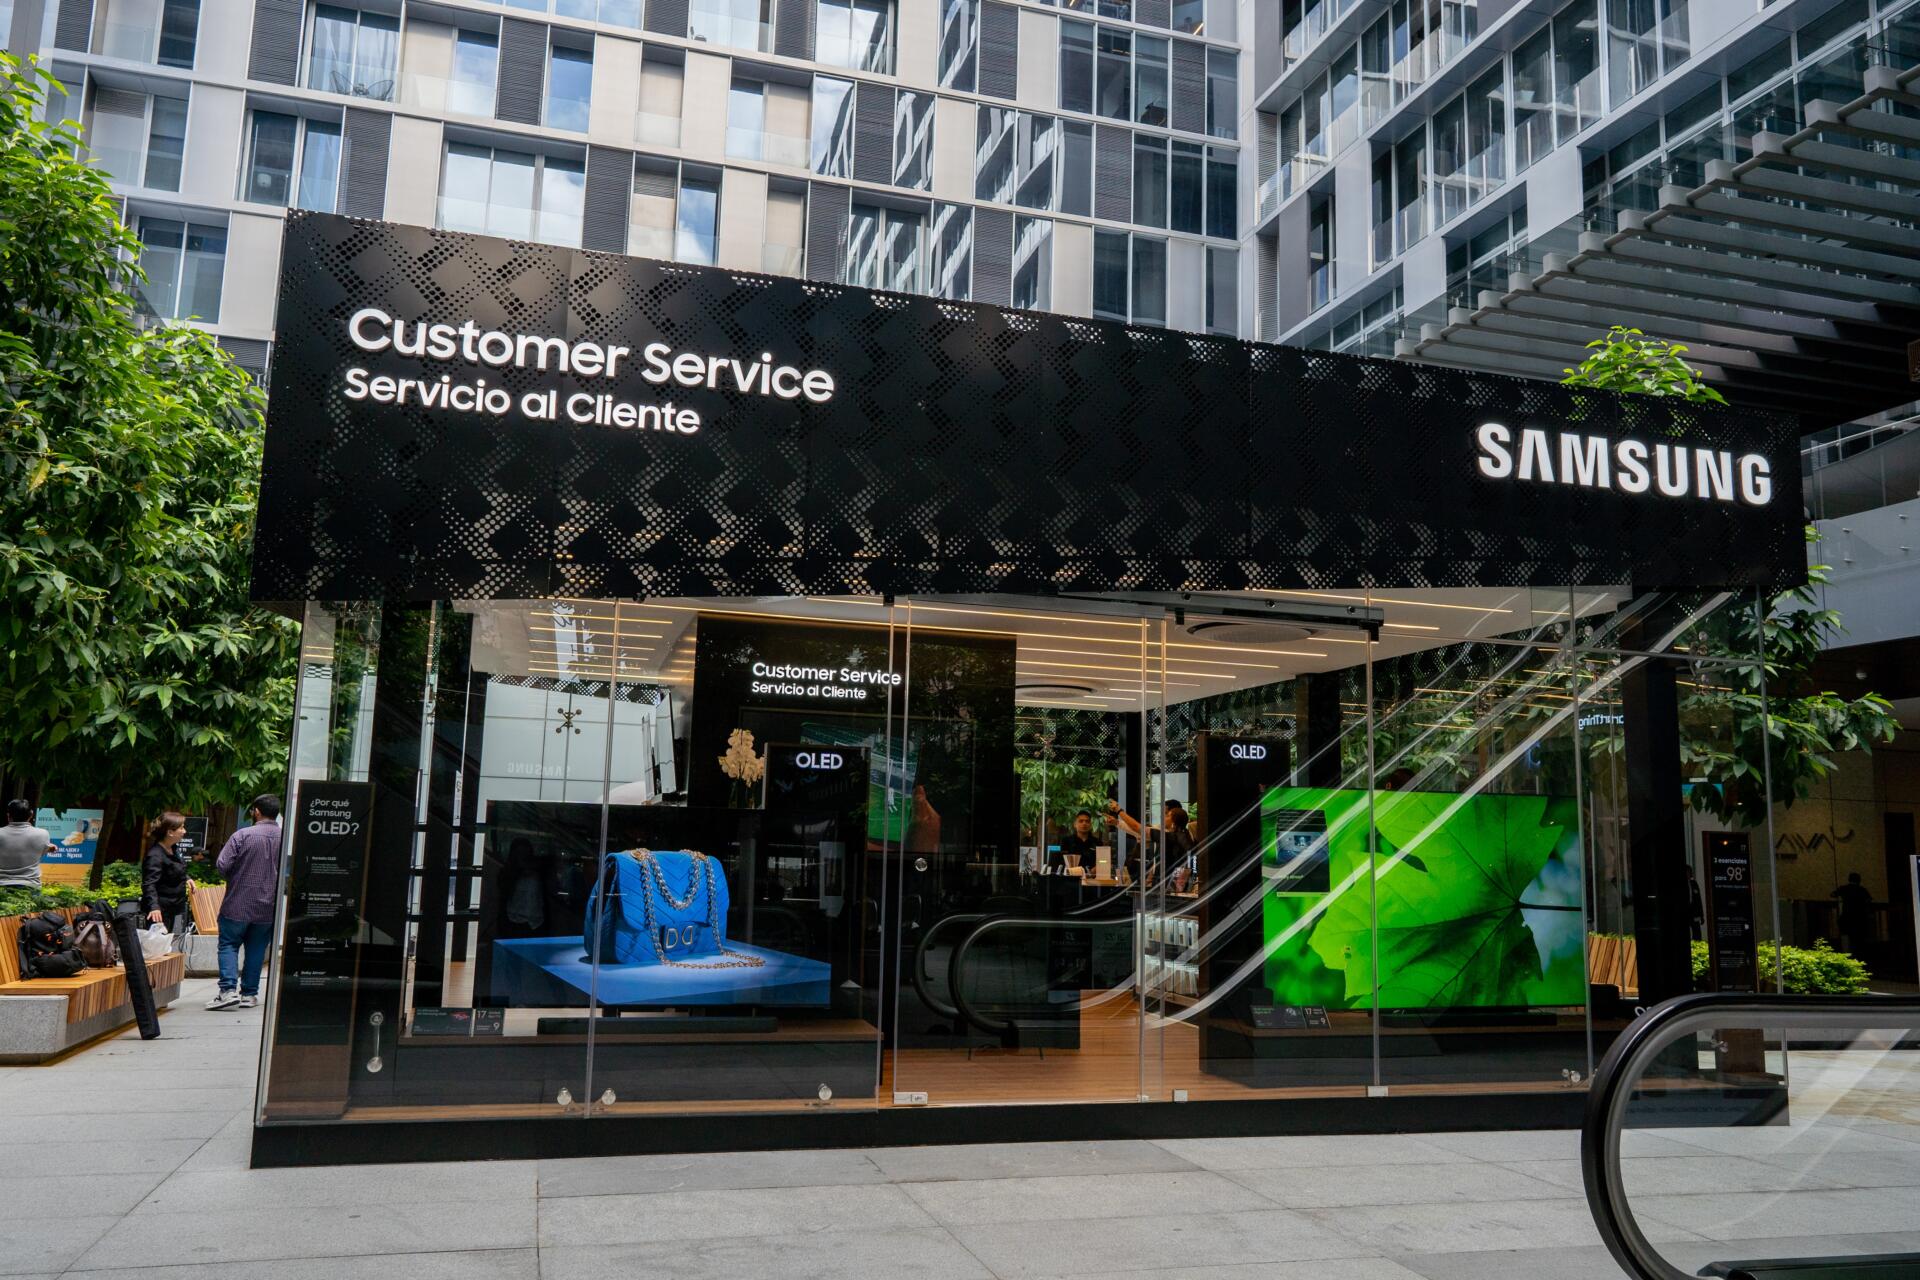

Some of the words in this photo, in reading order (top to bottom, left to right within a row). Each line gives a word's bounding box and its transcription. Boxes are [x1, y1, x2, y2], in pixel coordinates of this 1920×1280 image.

[348, 308, 630, 378] Customer
[641, 343, 836, 402] Service
[344, 367, 511, 415] Servicio
[521, 390, 556, 420] al
[567, 393, 700, 434] Cliente
[1477, 422, 1772, 505] SAMSUNG
[752, 662, 837, 681] Customer
[840, 668, 902, 685] Service
[752, 681, 805, 696] Servicio
[807, 685, 819, 697] al
[822, 686, 867, 699] Cliente
[1230, 744, 1266, 759] QLED
[795, 752, 843, 770] OLED
[310, 798, 330, 808] ¿Por
[331, 799, 350, 809] qué
[309, 808, 352, 820] Samsung
[308, 821, 360, 836] OLED?
[477, 1010, 487, 1018] 17
[493, 1022, 500, 1031] 9
